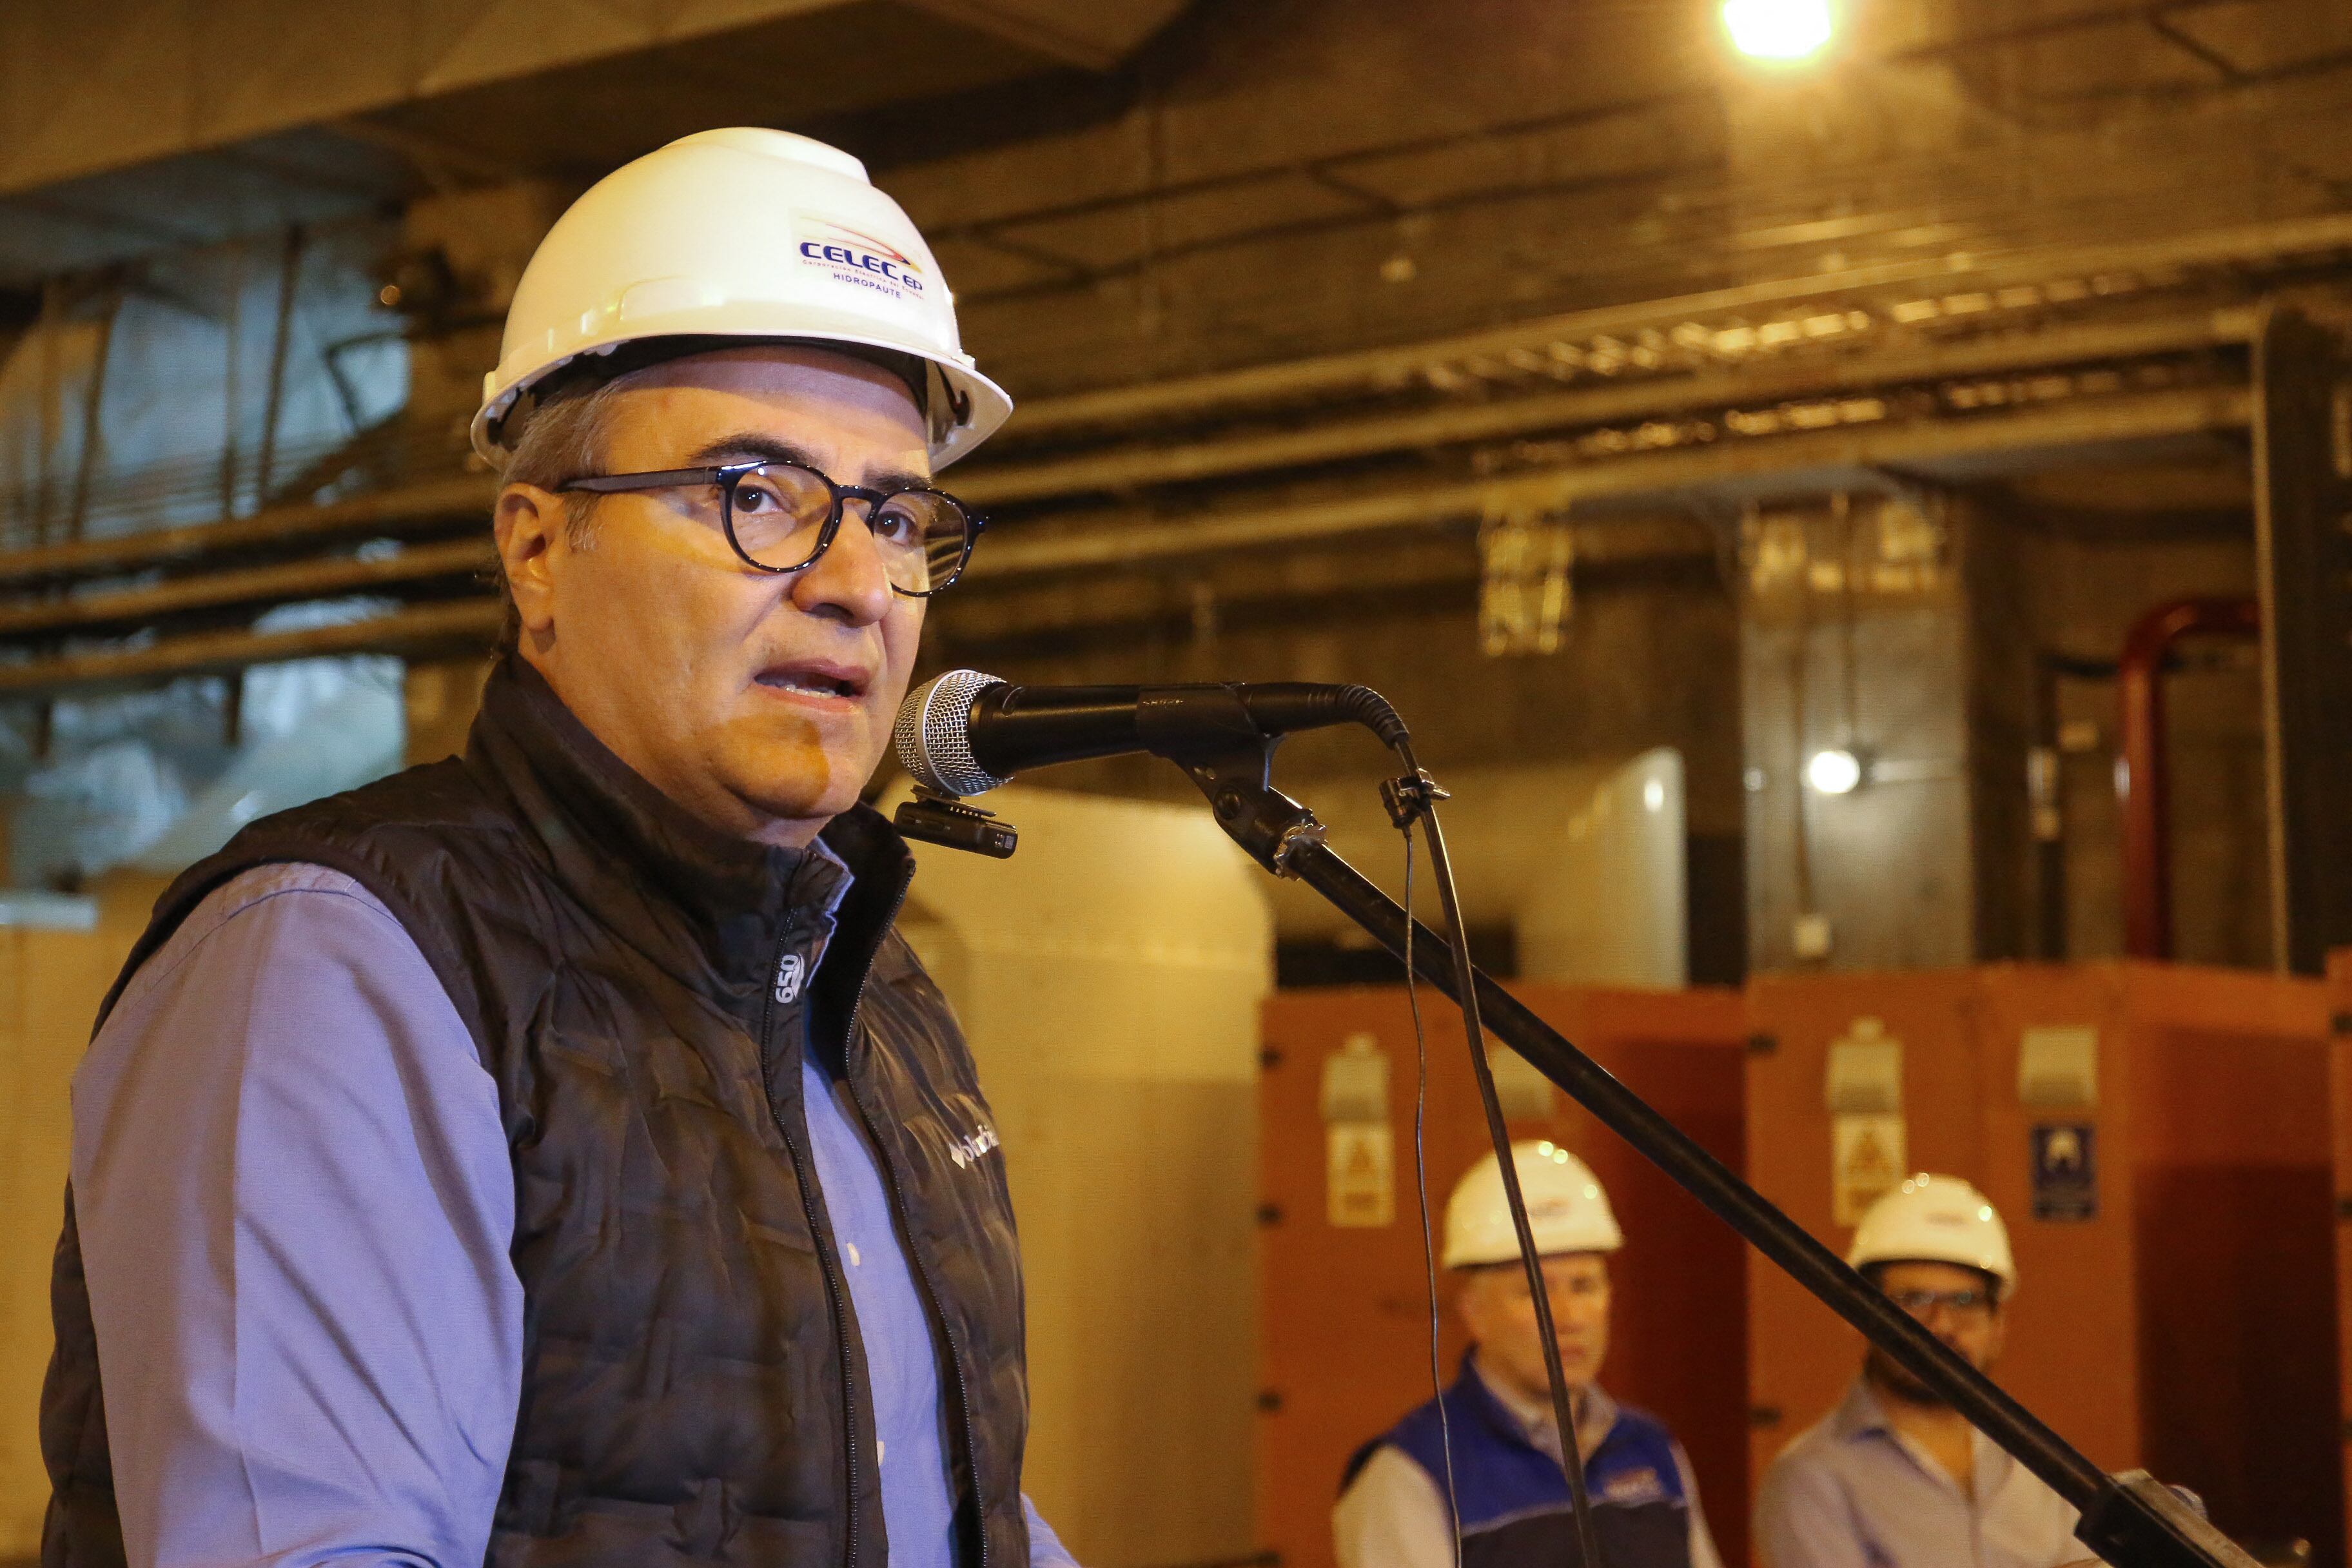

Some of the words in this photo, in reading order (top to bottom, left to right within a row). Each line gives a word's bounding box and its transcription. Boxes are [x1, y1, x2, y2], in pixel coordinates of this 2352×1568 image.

[800, 242, 898, 280] CELEC
[903, 275, 923, 290] EP
[834, 273, 901, 299] HIDROPAUTE
[776, 955, 799, 1003] 650
